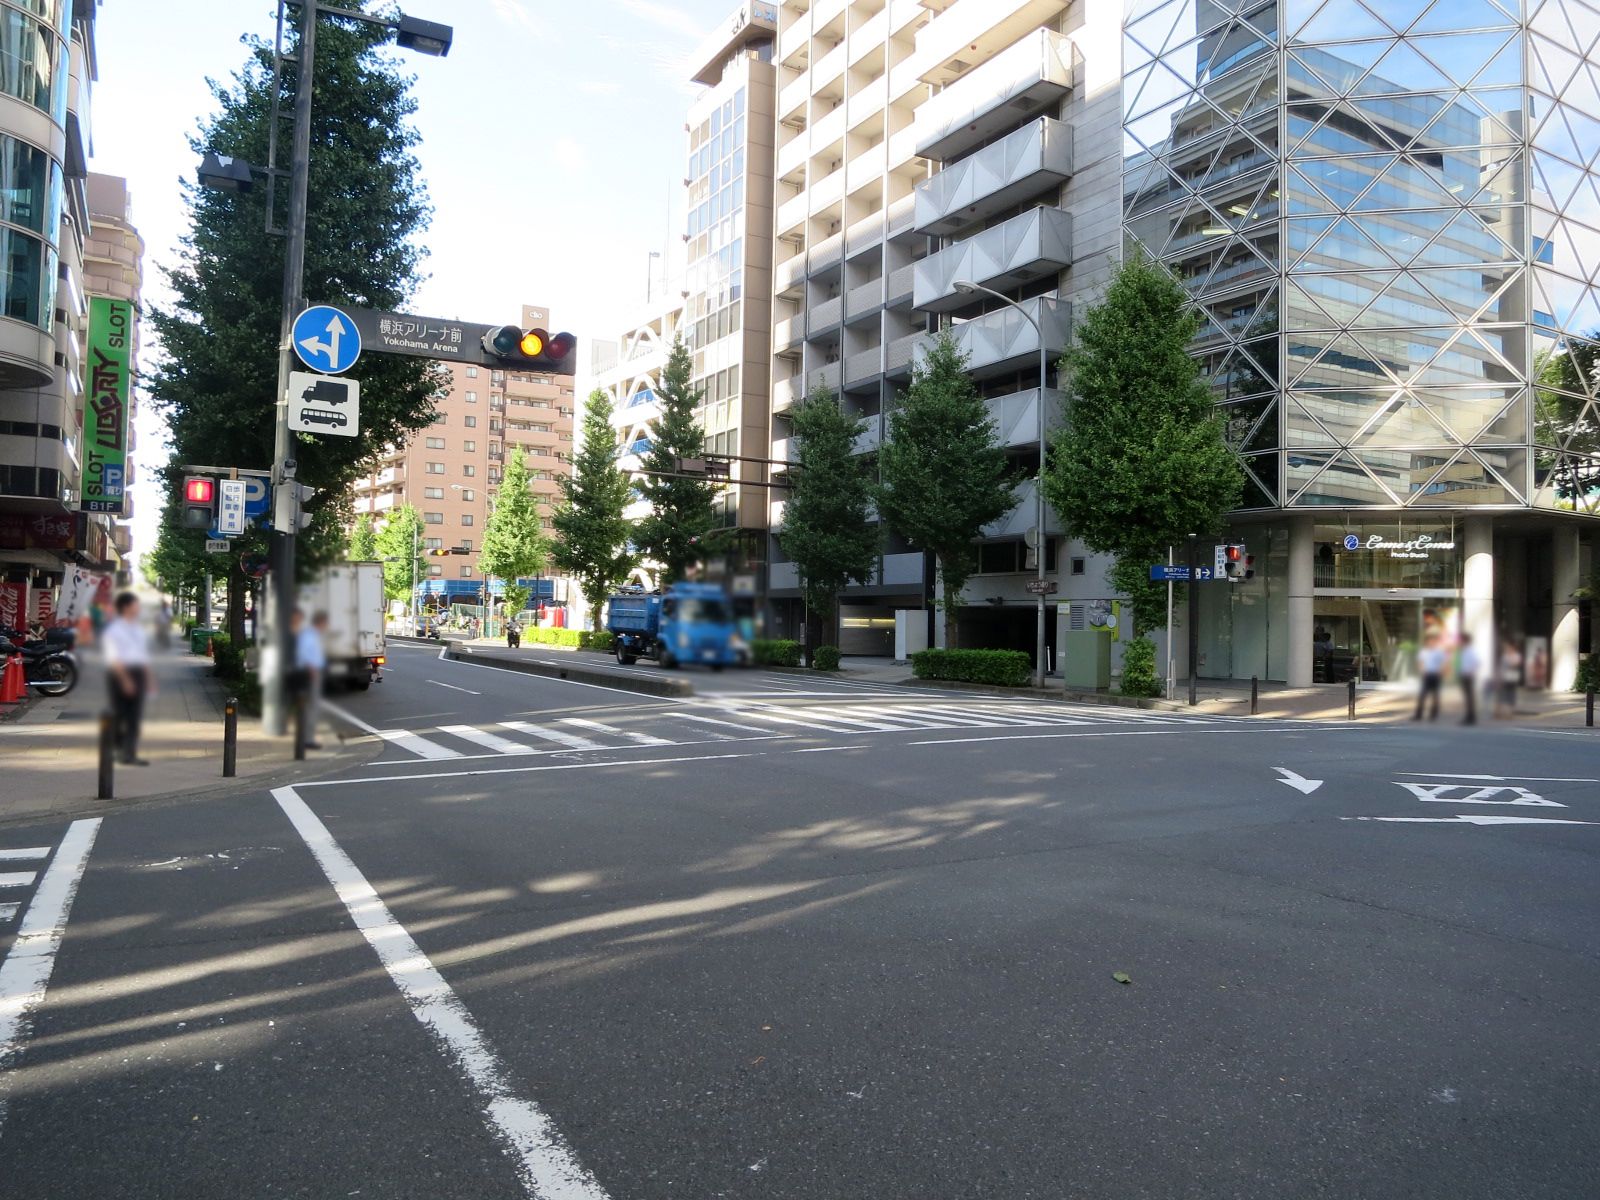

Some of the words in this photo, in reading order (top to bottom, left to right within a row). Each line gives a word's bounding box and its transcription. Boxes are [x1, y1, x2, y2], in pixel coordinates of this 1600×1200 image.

[108, 303, 127, 348] SLOT
[380, 319, 462, 343] 横浜アリーナ前
[384, 336, 429, 350] Yokohama
[432, 342, 458, 353] Arena
[87, 450, 105, 496] SLOT
[106, 469, 122, 484] P
[89, 501, 115, 511] B1F
